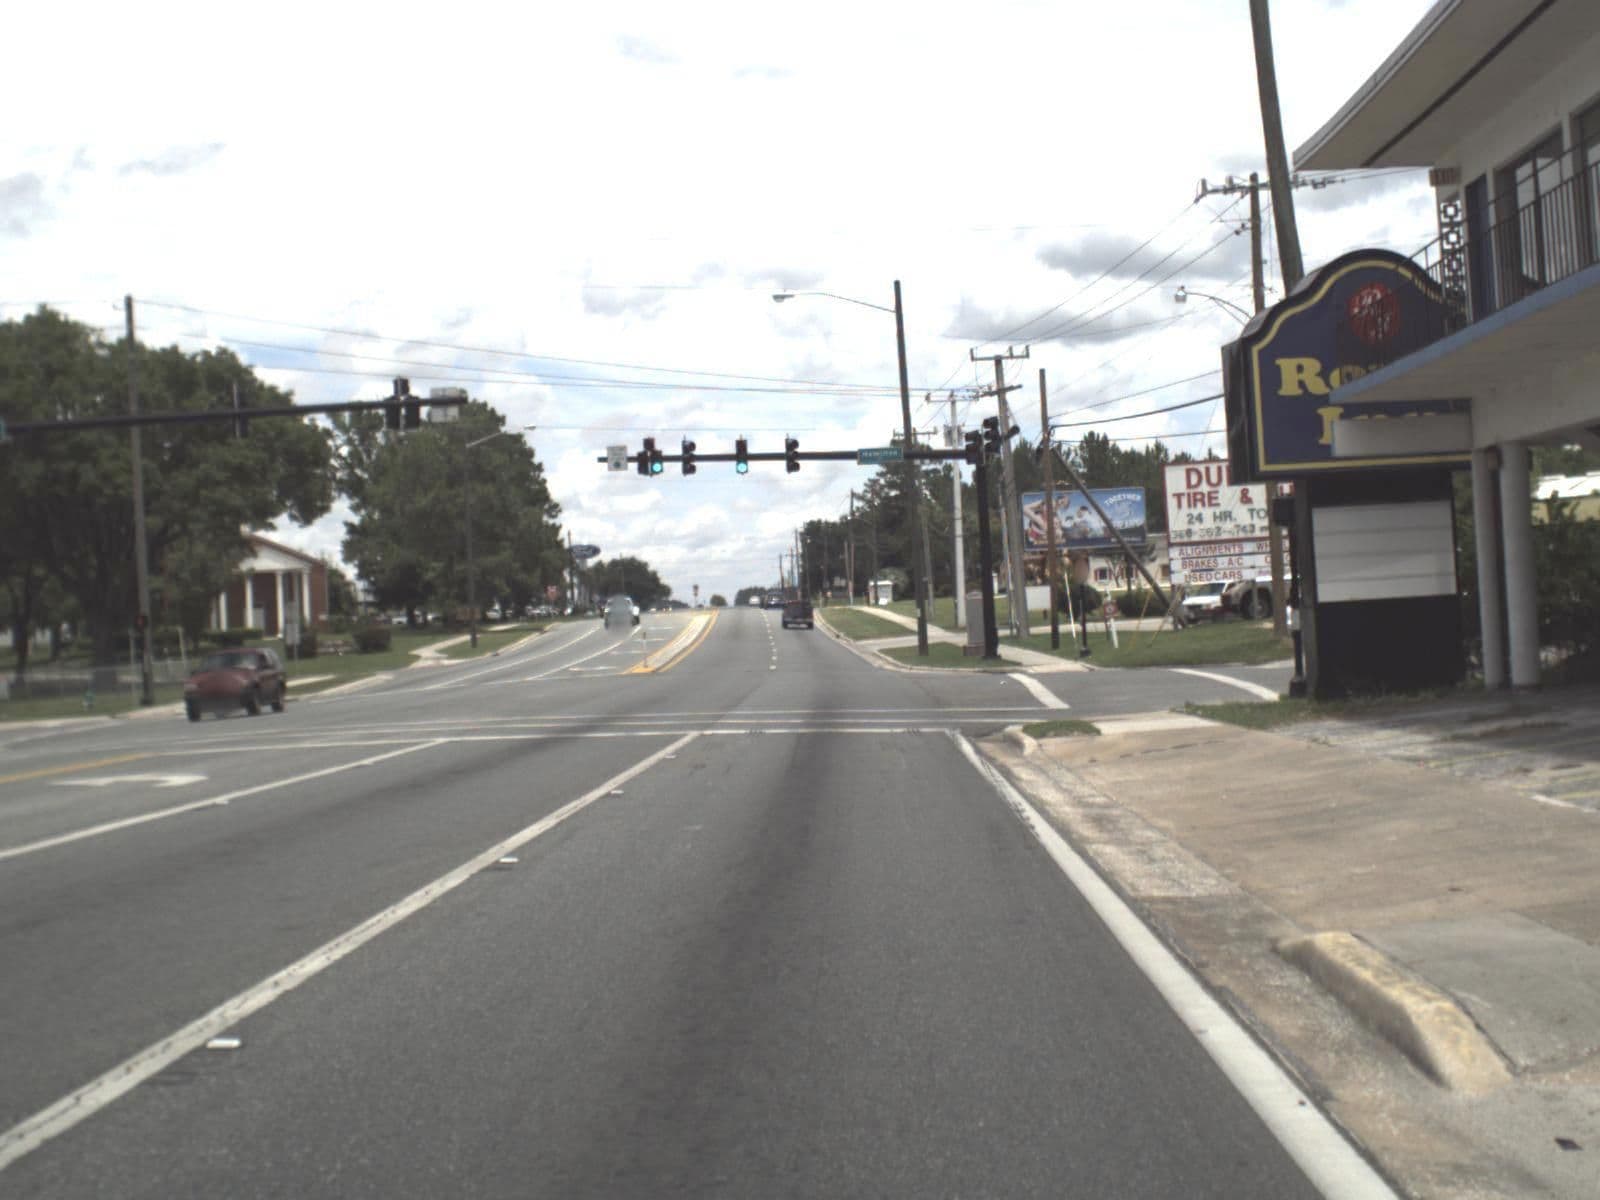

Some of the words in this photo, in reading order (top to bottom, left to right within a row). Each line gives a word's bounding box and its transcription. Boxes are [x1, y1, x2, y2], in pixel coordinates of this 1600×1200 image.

[1173, 490, 1221, 509] TIRE
[1240, 487, 1254, 504] &
[1187, 512, 1203, 525] 24
[1213, 510, 1237, 522] HR.
[1248, 507, 1268, 520] TO
[1178, 543, 1244, 557] ALIGNMENTS
[1181, 558, 1218, 570] BRAKES
[1185, 570, 1213, 583] USED
[1214, 568, 1243, 581] CARS
